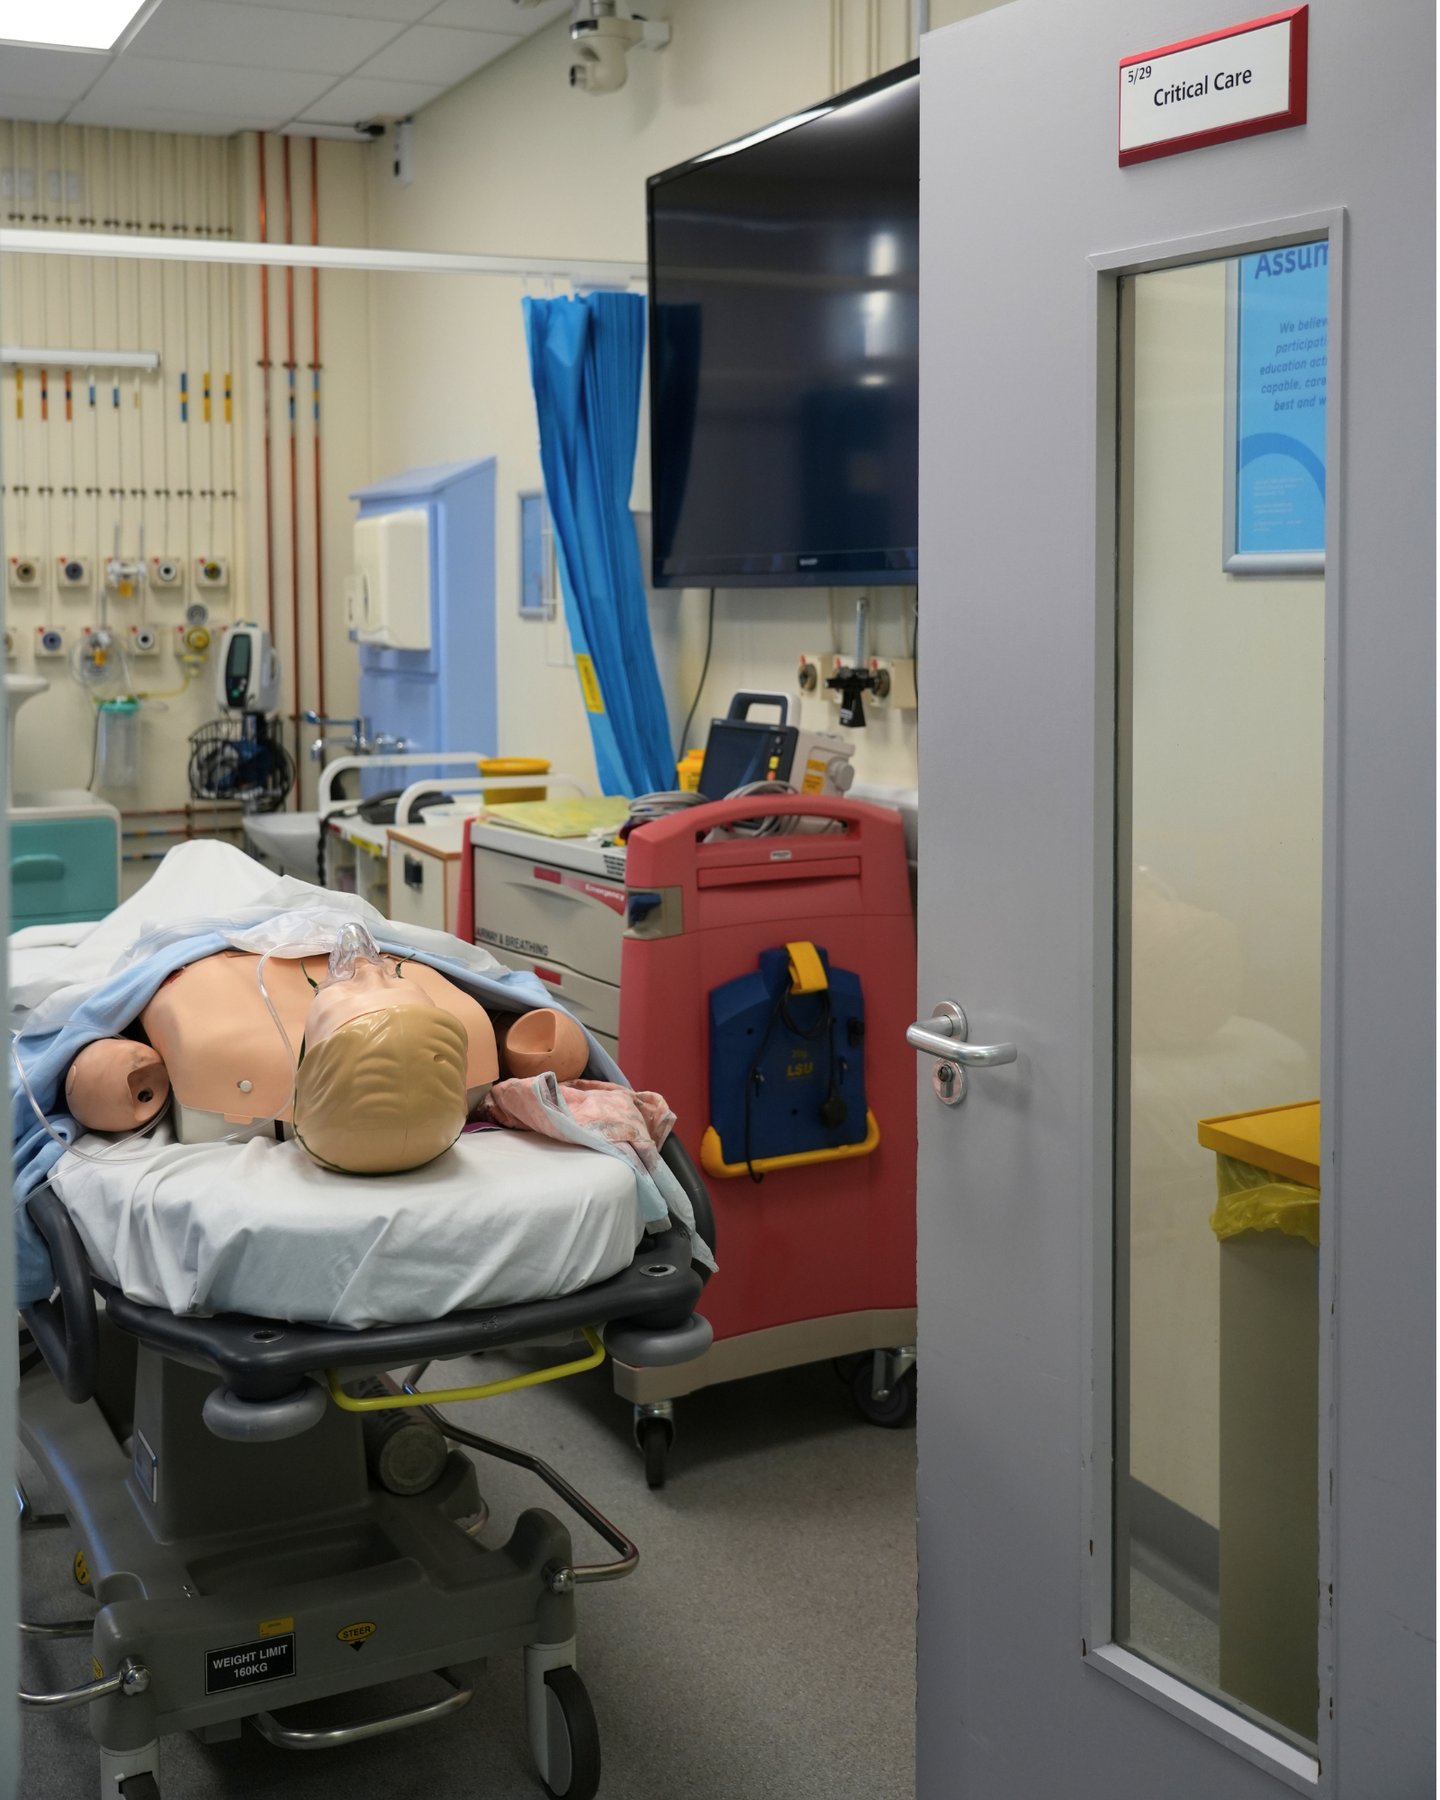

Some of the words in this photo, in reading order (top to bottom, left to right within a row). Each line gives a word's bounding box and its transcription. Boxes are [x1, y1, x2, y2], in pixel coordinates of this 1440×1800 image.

[1127, 65, 1152, 85] 5/29
[1153, 75, 1208, 107] Critical
[1214, 69, 1252, 91] Care
[1280, 320, 1295, 334] We
[1260, 360, 1307, 375] education
[1261, 379, 1302, 395] capable,
[1274, 398, 1295, 411] best
[1297, 395, 1316, 409] and
[505, 935, 549, 956] BREATHING
[342, 1626, 371, 1639] STEER
[212, 1651, 257, 1670] WEIGHT
[259, 1644, 289, 1660] LIMIT
[234, 1663, 268, 1679] 160KG
